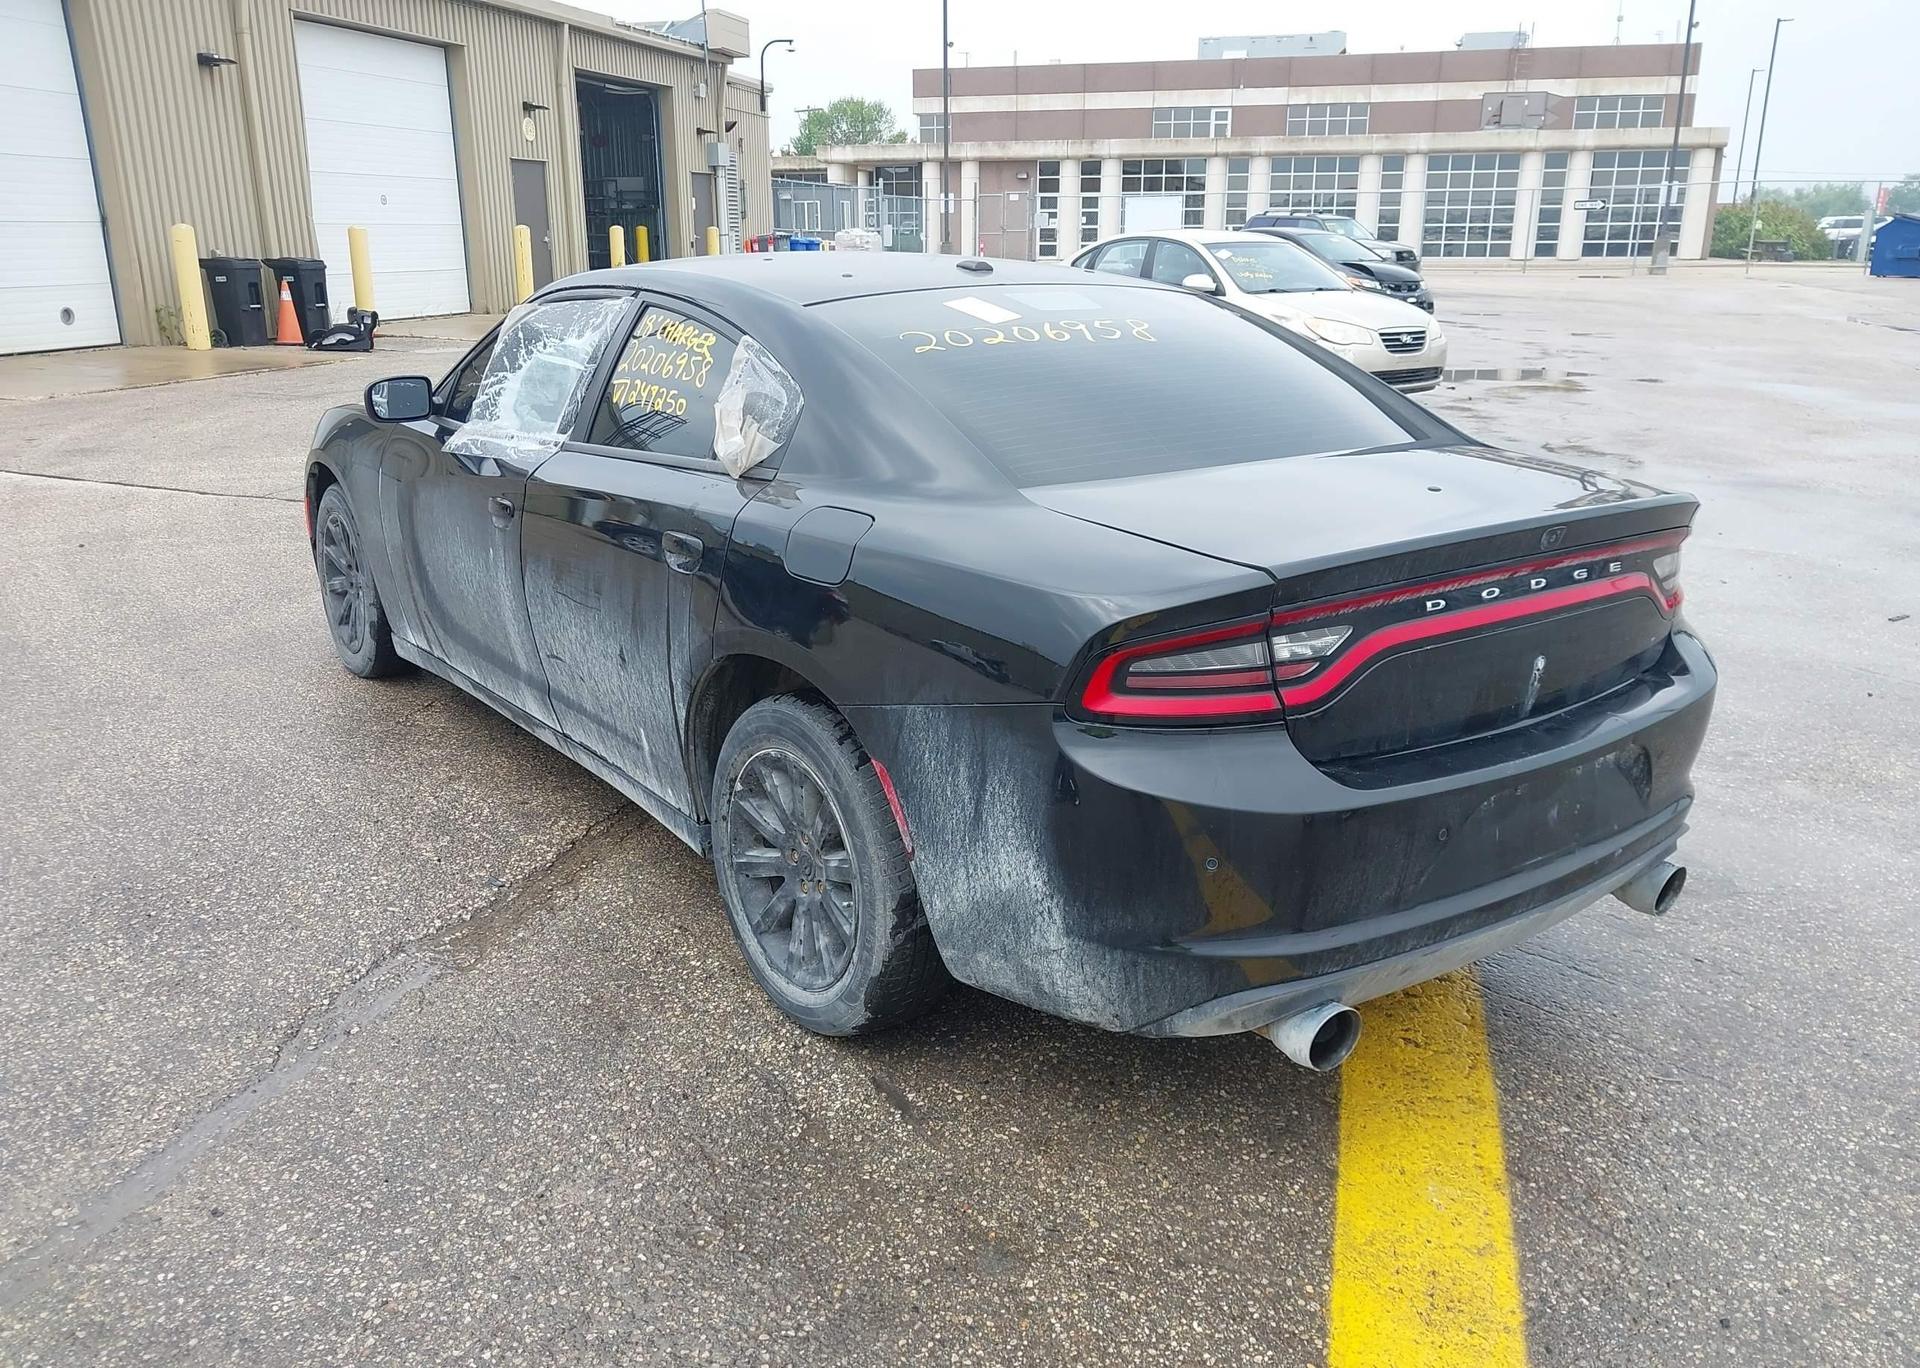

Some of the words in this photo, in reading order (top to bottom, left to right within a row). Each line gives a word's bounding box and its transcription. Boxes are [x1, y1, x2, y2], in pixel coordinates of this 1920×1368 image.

[656, 318, 716, 358] CHARGER
[899, 319, 1158, 353] 20206958
[618, 339, 714, 388] 20206958
[1426, 561, 1622, 612] DODGE
